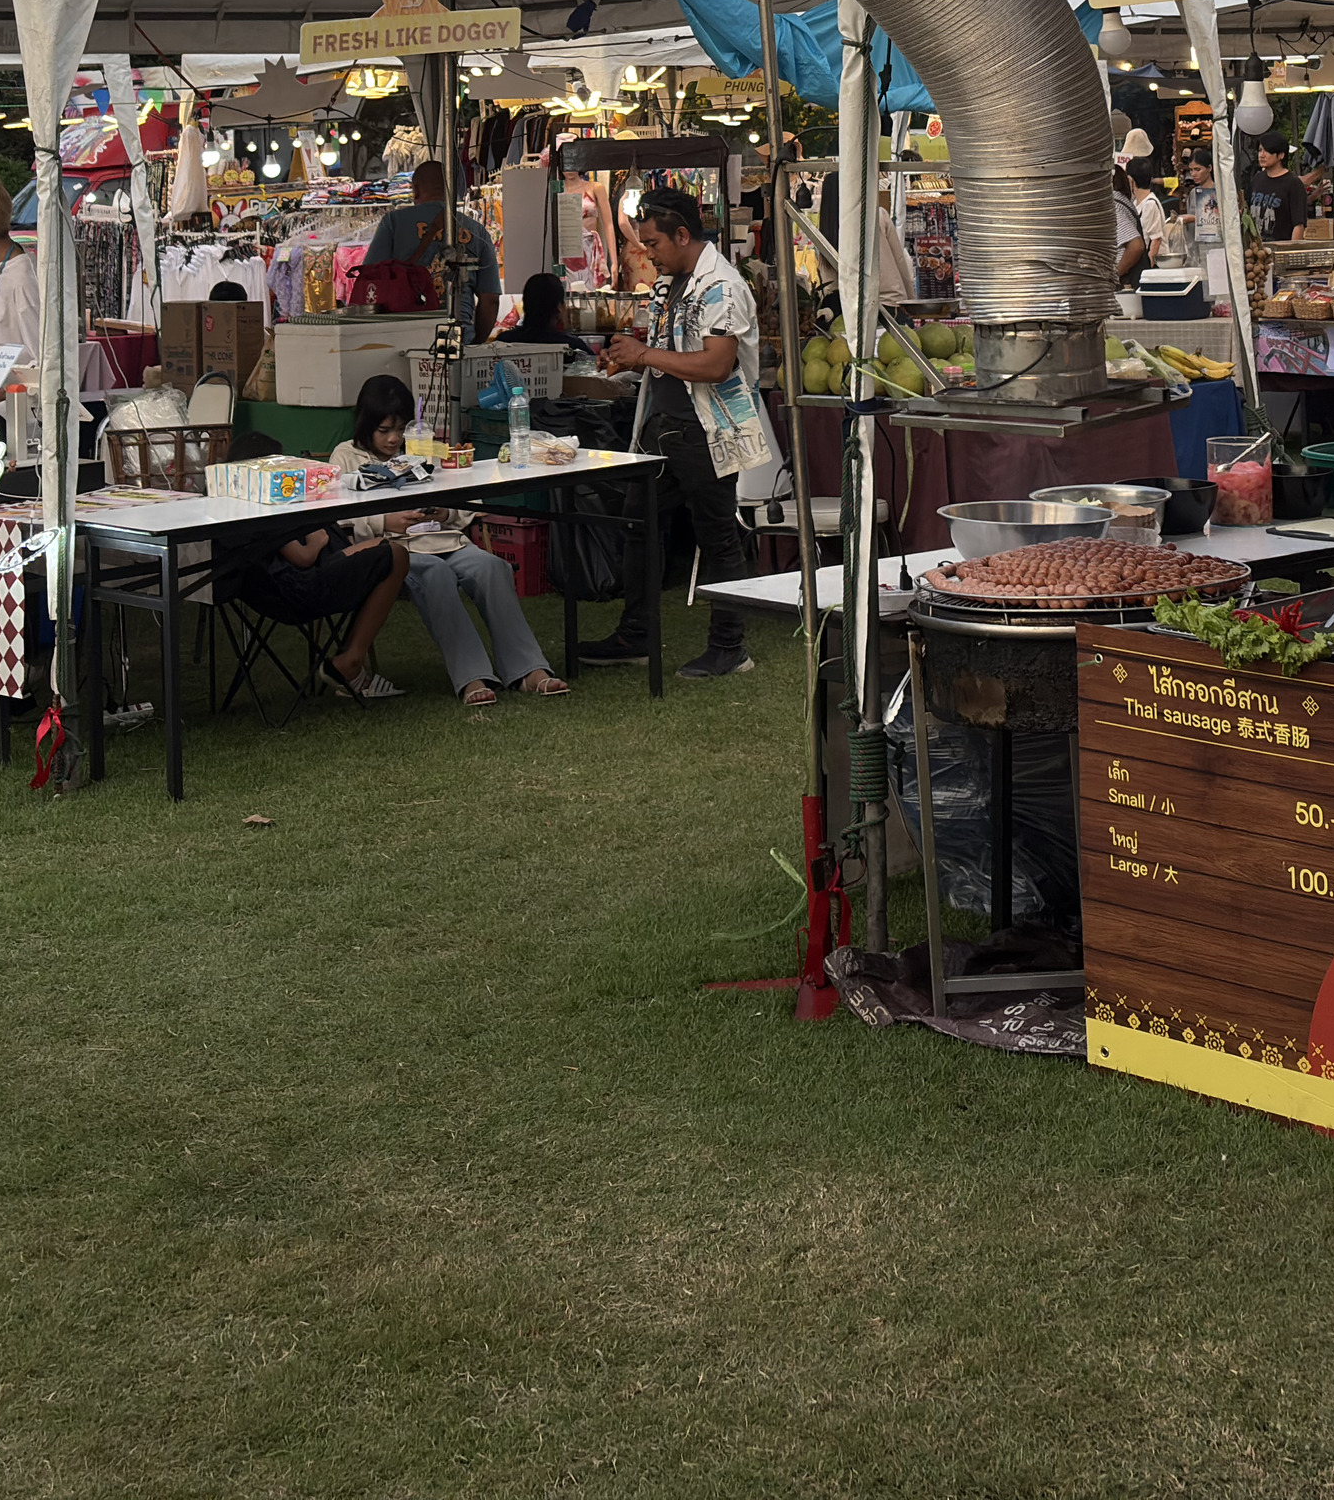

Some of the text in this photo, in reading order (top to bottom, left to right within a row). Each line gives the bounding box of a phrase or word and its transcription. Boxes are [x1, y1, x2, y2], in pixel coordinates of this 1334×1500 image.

[312, 21, 511, 54] FRESH LIKE DOGGY
[1148, 664, 1279, 715] ไส้กรอกอีสาน
[1124, 697, 1310, 749] Thai sausage 泰式香肠
[1108, 760, 1130, 782] เล็ก
[1108, 788, 1145, 809] Small
[1161, 798, 1176, 815] 小
[1109, 827, 1138, 854] ใหญ่
[1109, 855, 1148, 877] Large
[1164, 865, 1179, 884] 大
